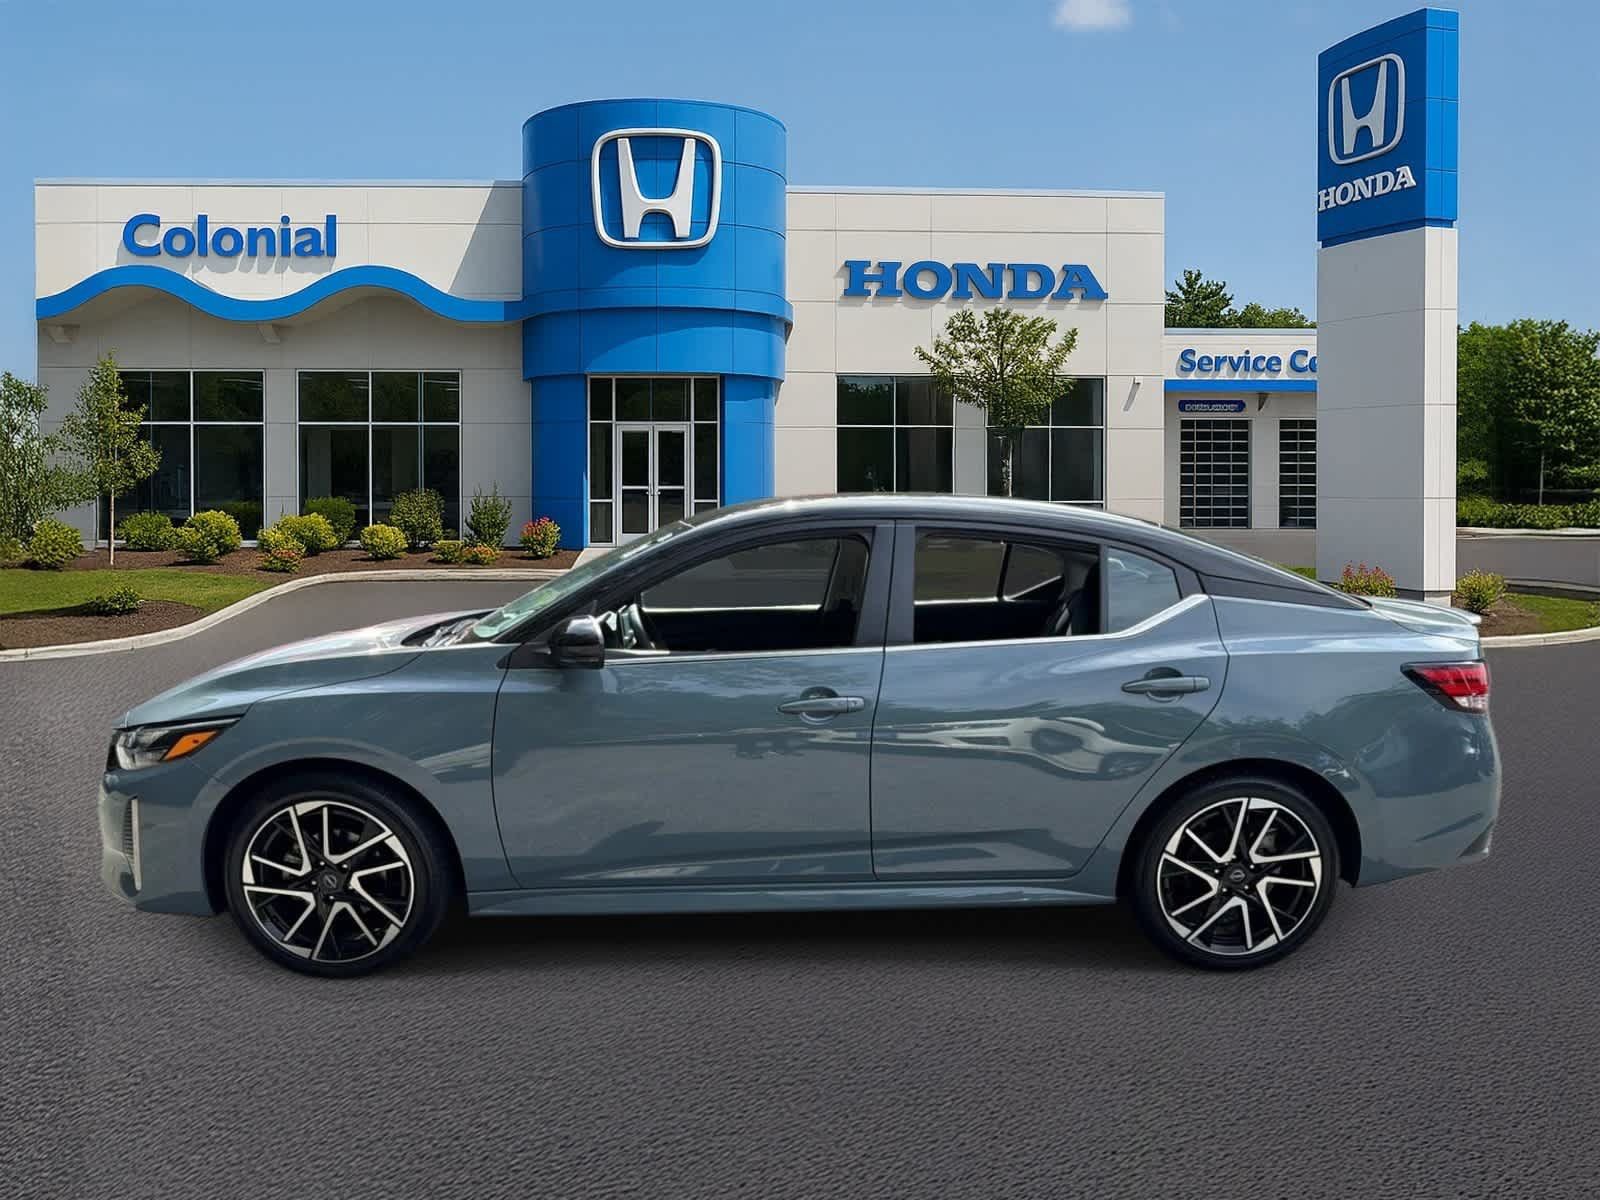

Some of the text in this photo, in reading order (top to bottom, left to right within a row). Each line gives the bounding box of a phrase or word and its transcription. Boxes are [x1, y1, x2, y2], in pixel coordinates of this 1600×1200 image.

[1318, 165, 1416, 212] HONDA
[122, 213, 337, 258] Colonial
[842, 259, 1108, 301] HONDA
[1180, 348, 1281, 373] Service
